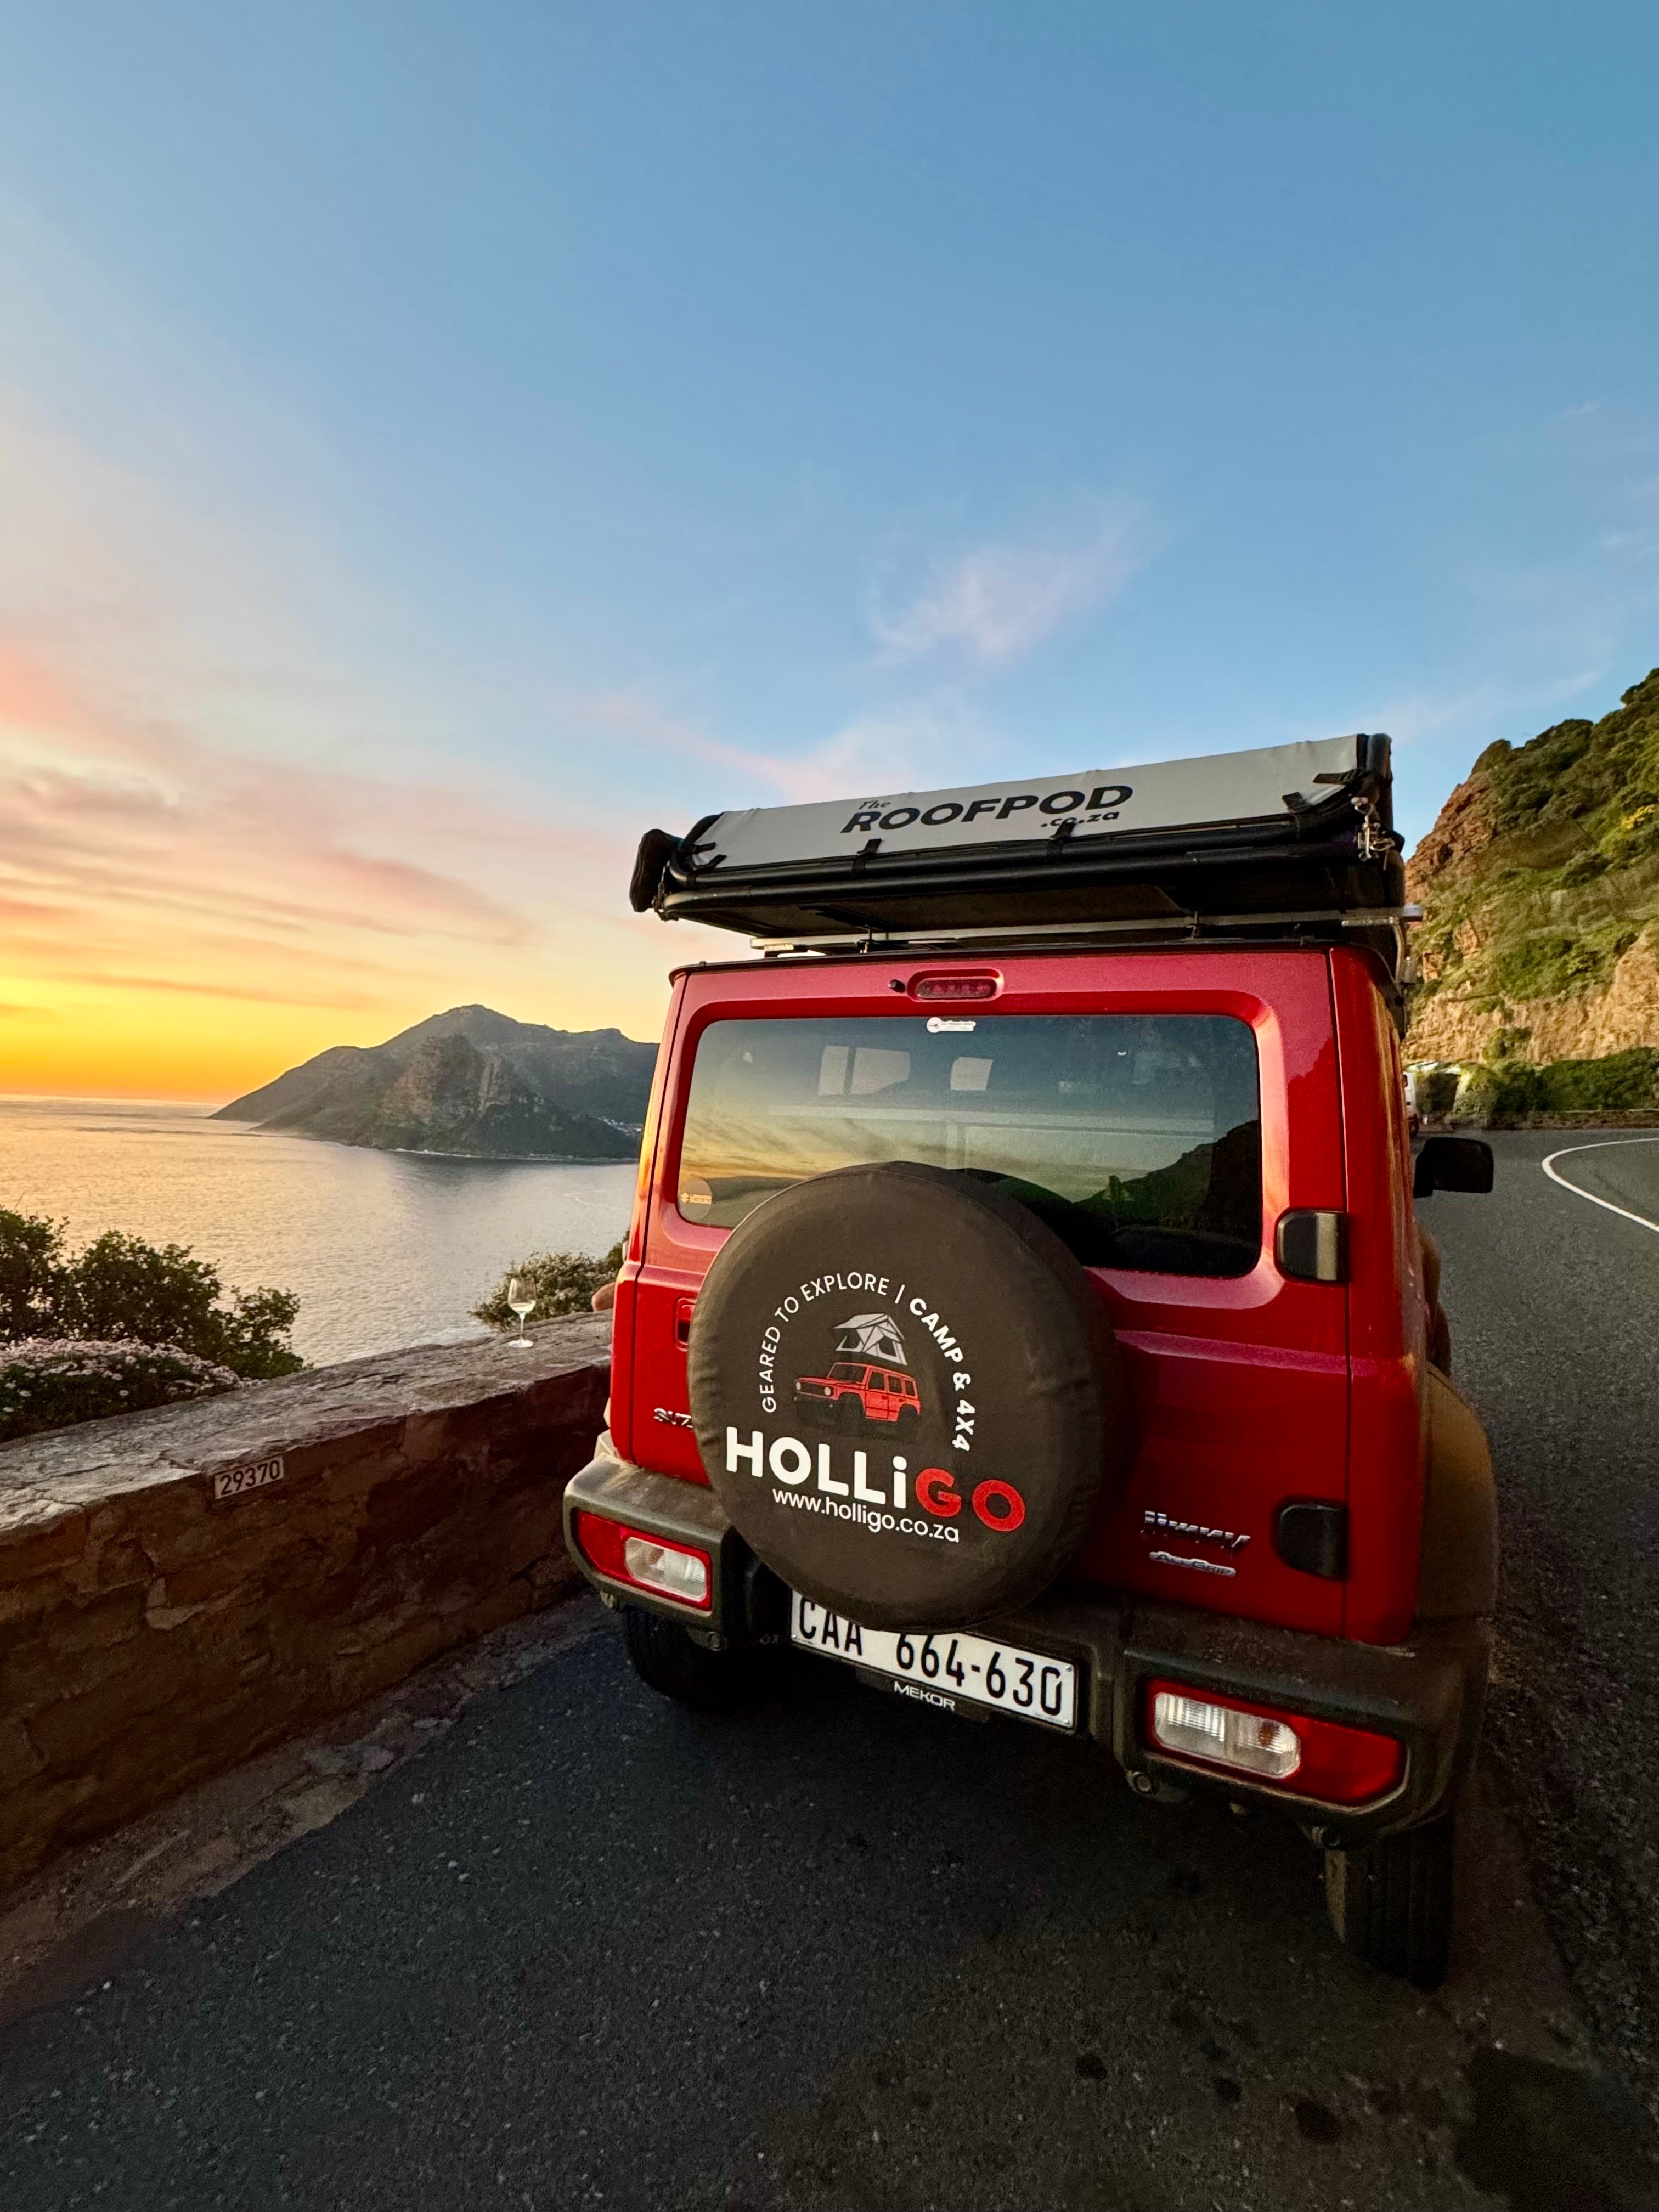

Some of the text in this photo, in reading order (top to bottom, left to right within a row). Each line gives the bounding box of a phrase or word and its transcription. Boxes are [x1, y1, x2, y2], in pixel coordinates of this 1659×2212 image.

[840, 785, 1133, 834] ROOFPOD
[858, 800, 891, 810] The
[800, 1272, 890, 1302] EXPLORE
[774, 1296, 799, 1322] TO
[910, 1297, 963, 1362] CAMP
[759, 1326, 780, 1413] GEARED
[952, 1372, 971, 1391] &
[952, 1399, 975, 1451] 4X4
[219, 1460, 280, 1496] 29370
[772, 1488, 960, 1543] www.holligo.co.za
[799, 1596, 1062, 1716] CAA 664-630
[894, 1681, 956, 1711] MEKOR
